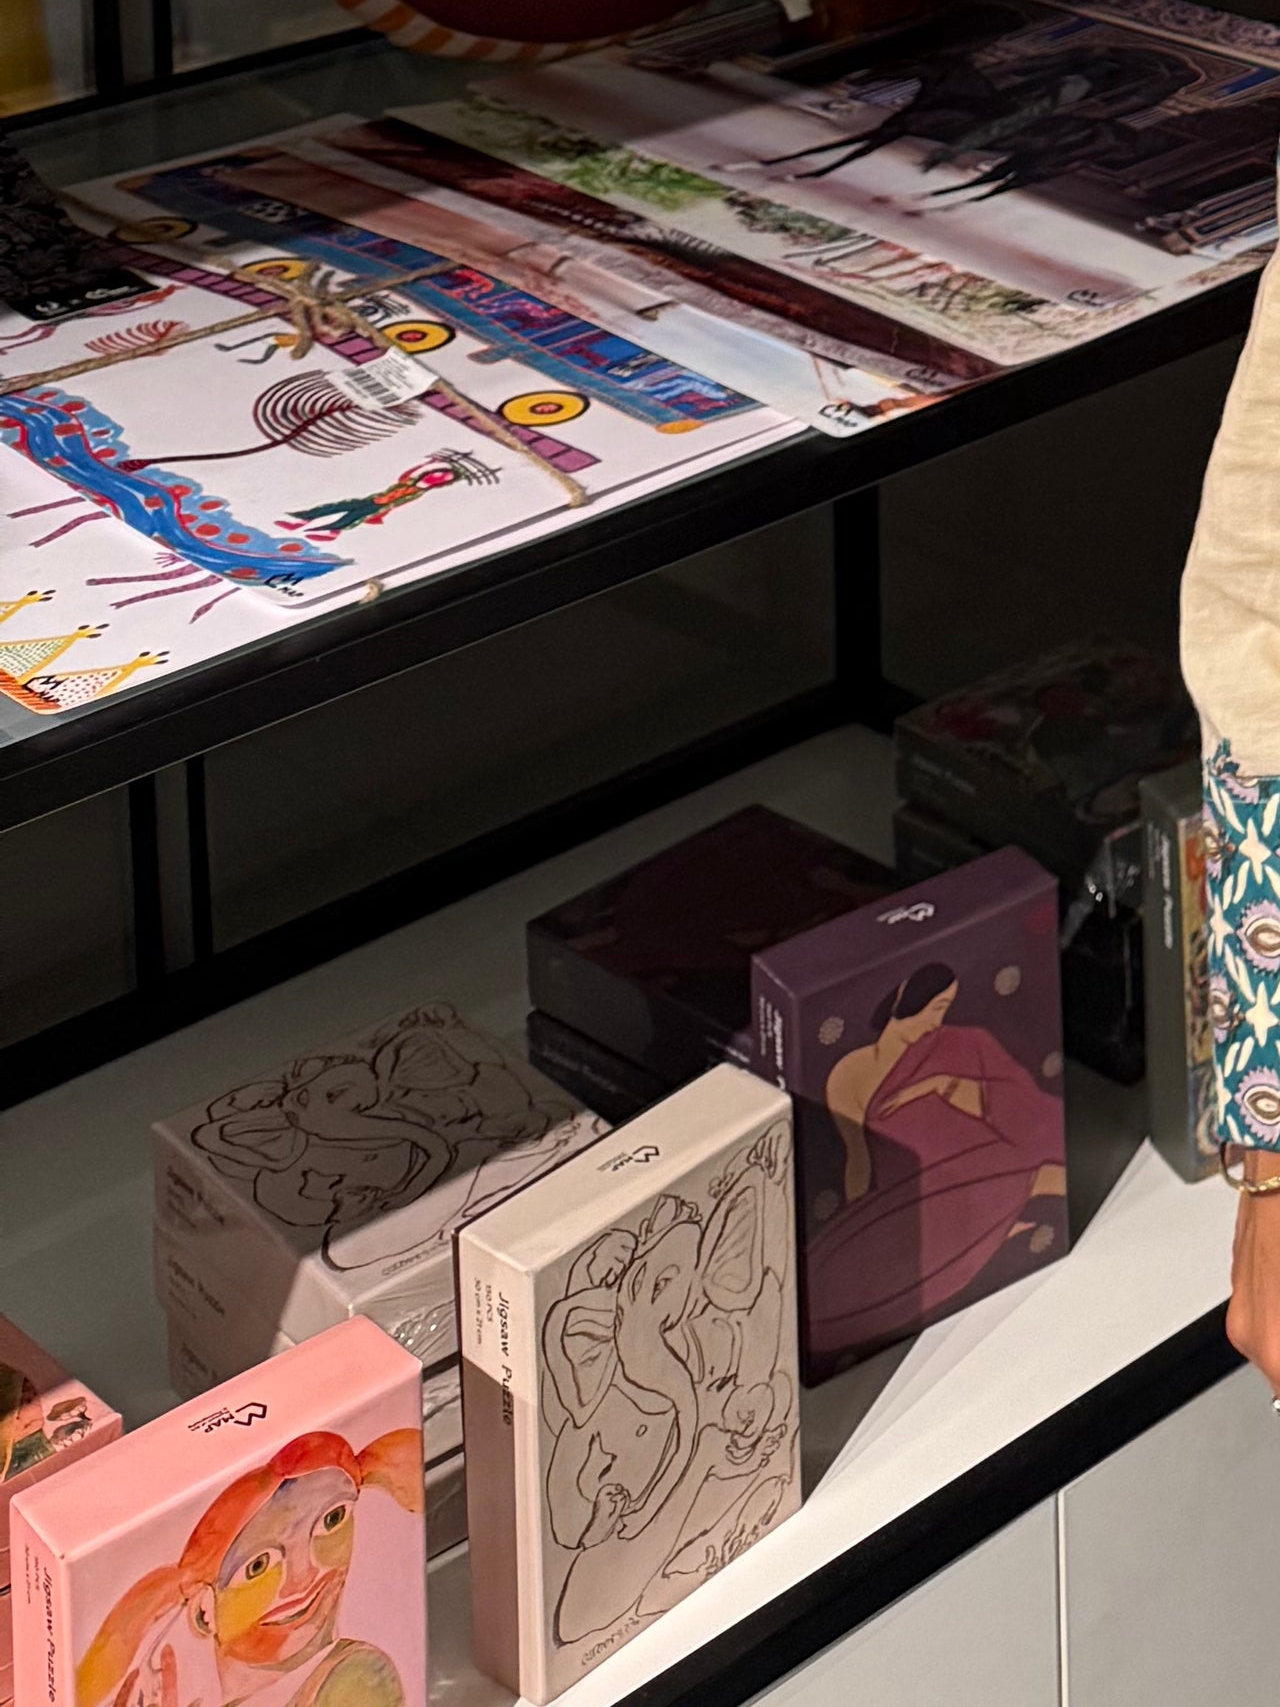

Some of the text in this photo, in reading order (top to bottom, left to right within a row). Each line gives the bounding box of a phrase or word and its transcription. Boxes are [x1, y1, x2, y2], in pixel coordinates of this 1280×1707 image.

[497, 1291, 513, 1426] Jigsaw Puzzle
[43, 1567, 56, 1703] Jigsaw Puzzle
